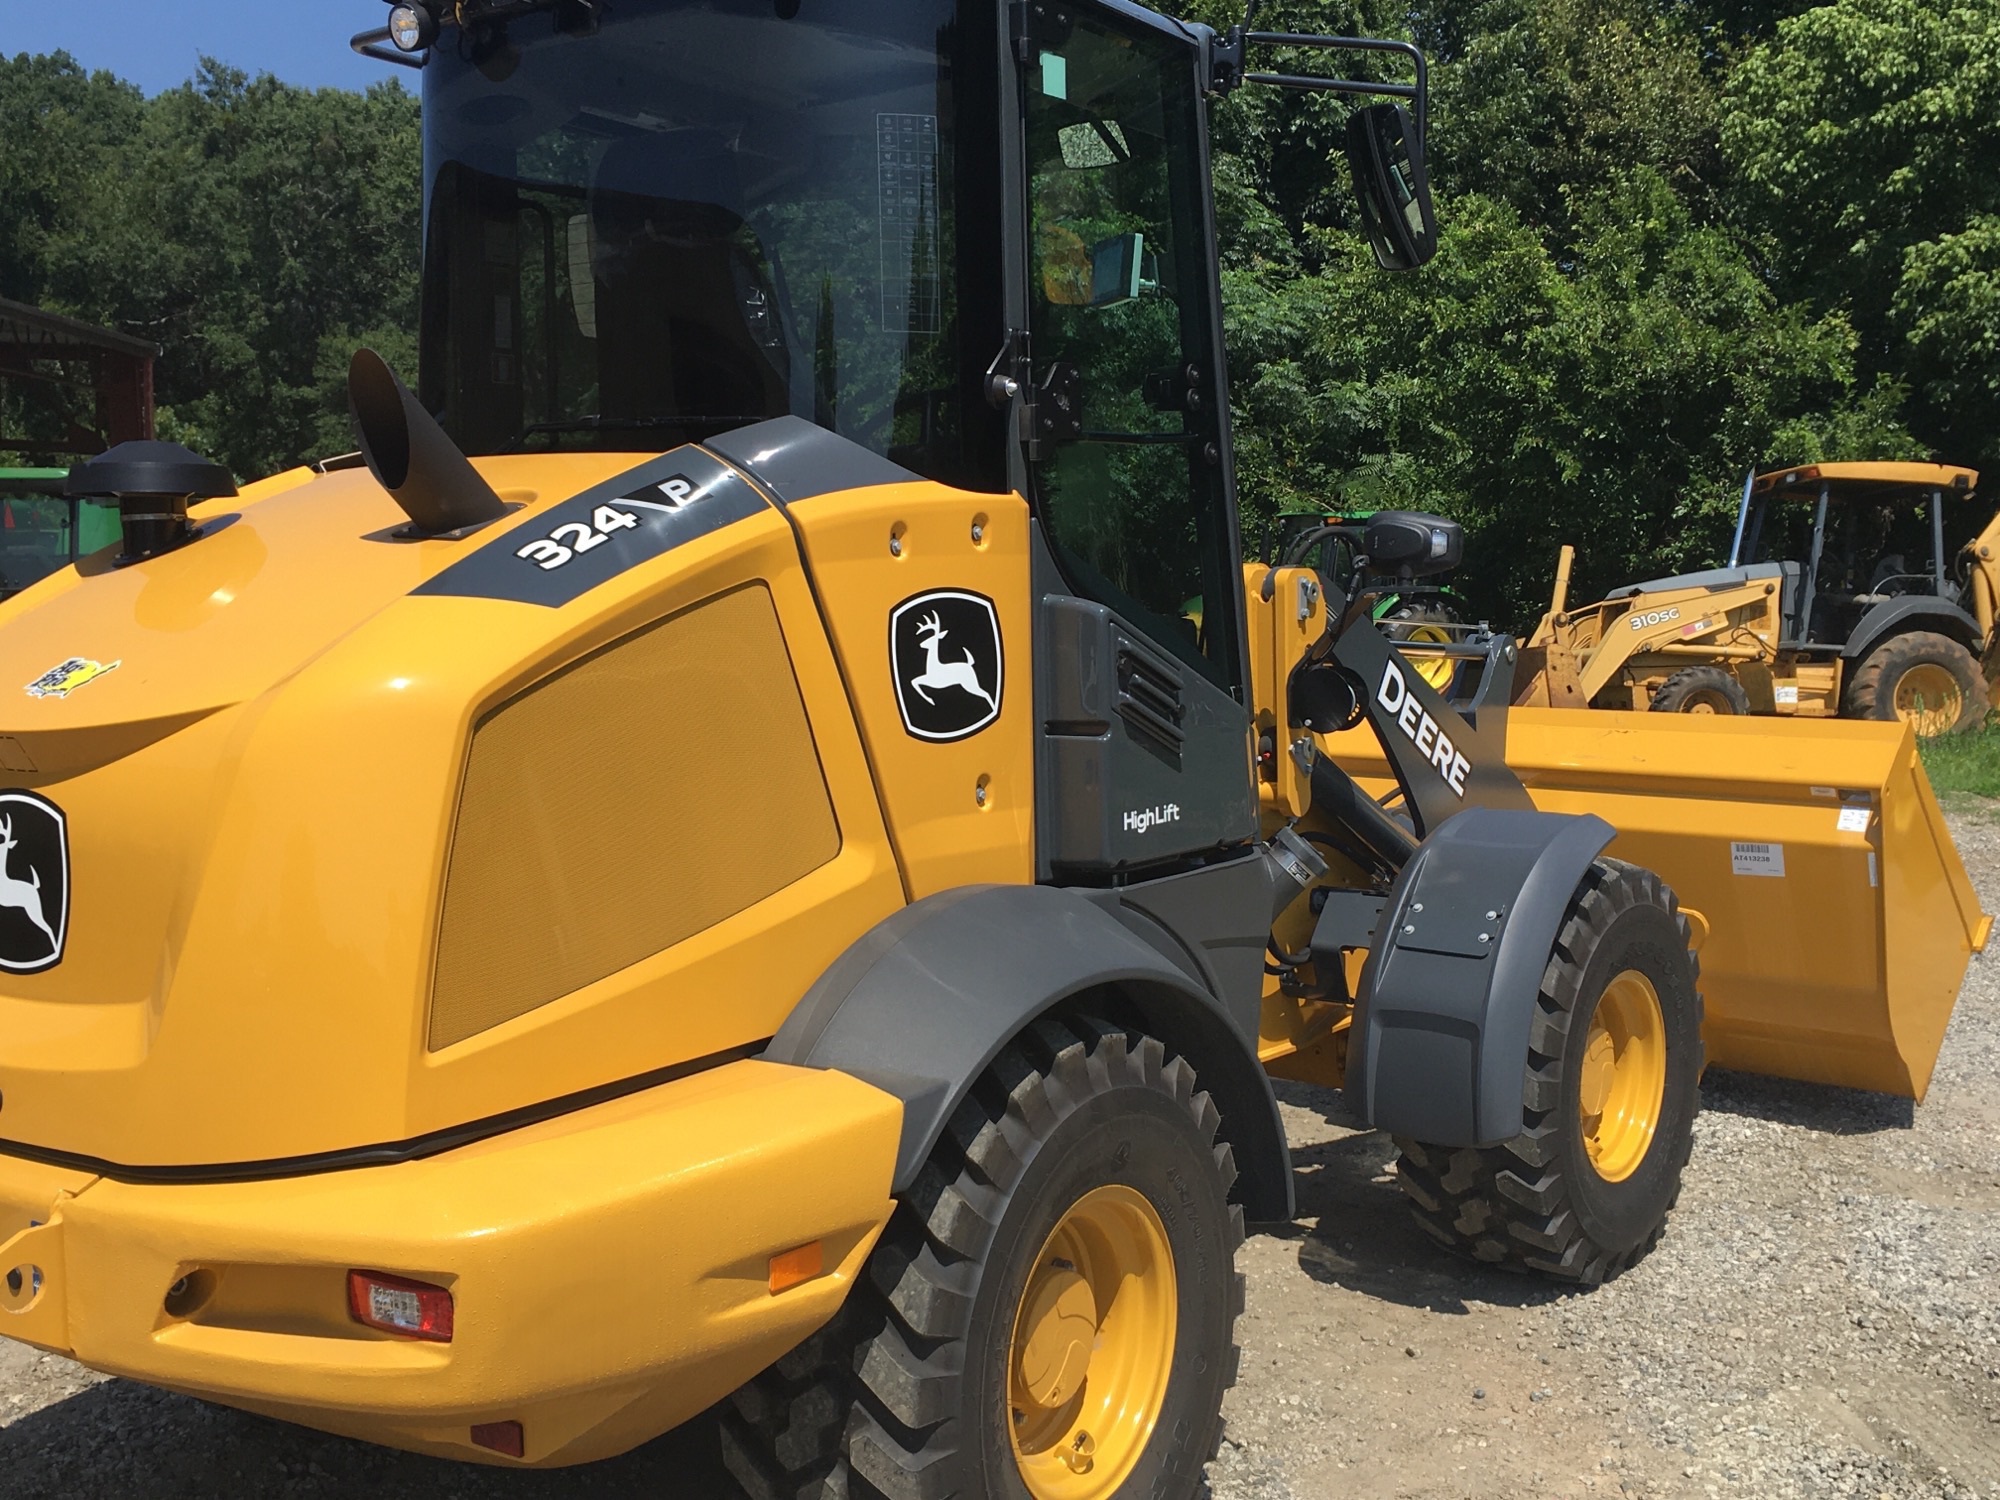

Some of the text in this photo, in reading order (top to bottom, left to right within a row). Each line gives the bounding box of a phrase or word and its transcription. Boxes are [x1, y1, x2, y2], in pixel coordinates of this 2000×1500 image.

[515, 504, 638, 571] 324
[1630, 608, 1680, 631] 310SG
[1377, 659, 1471, 797] DEERE
